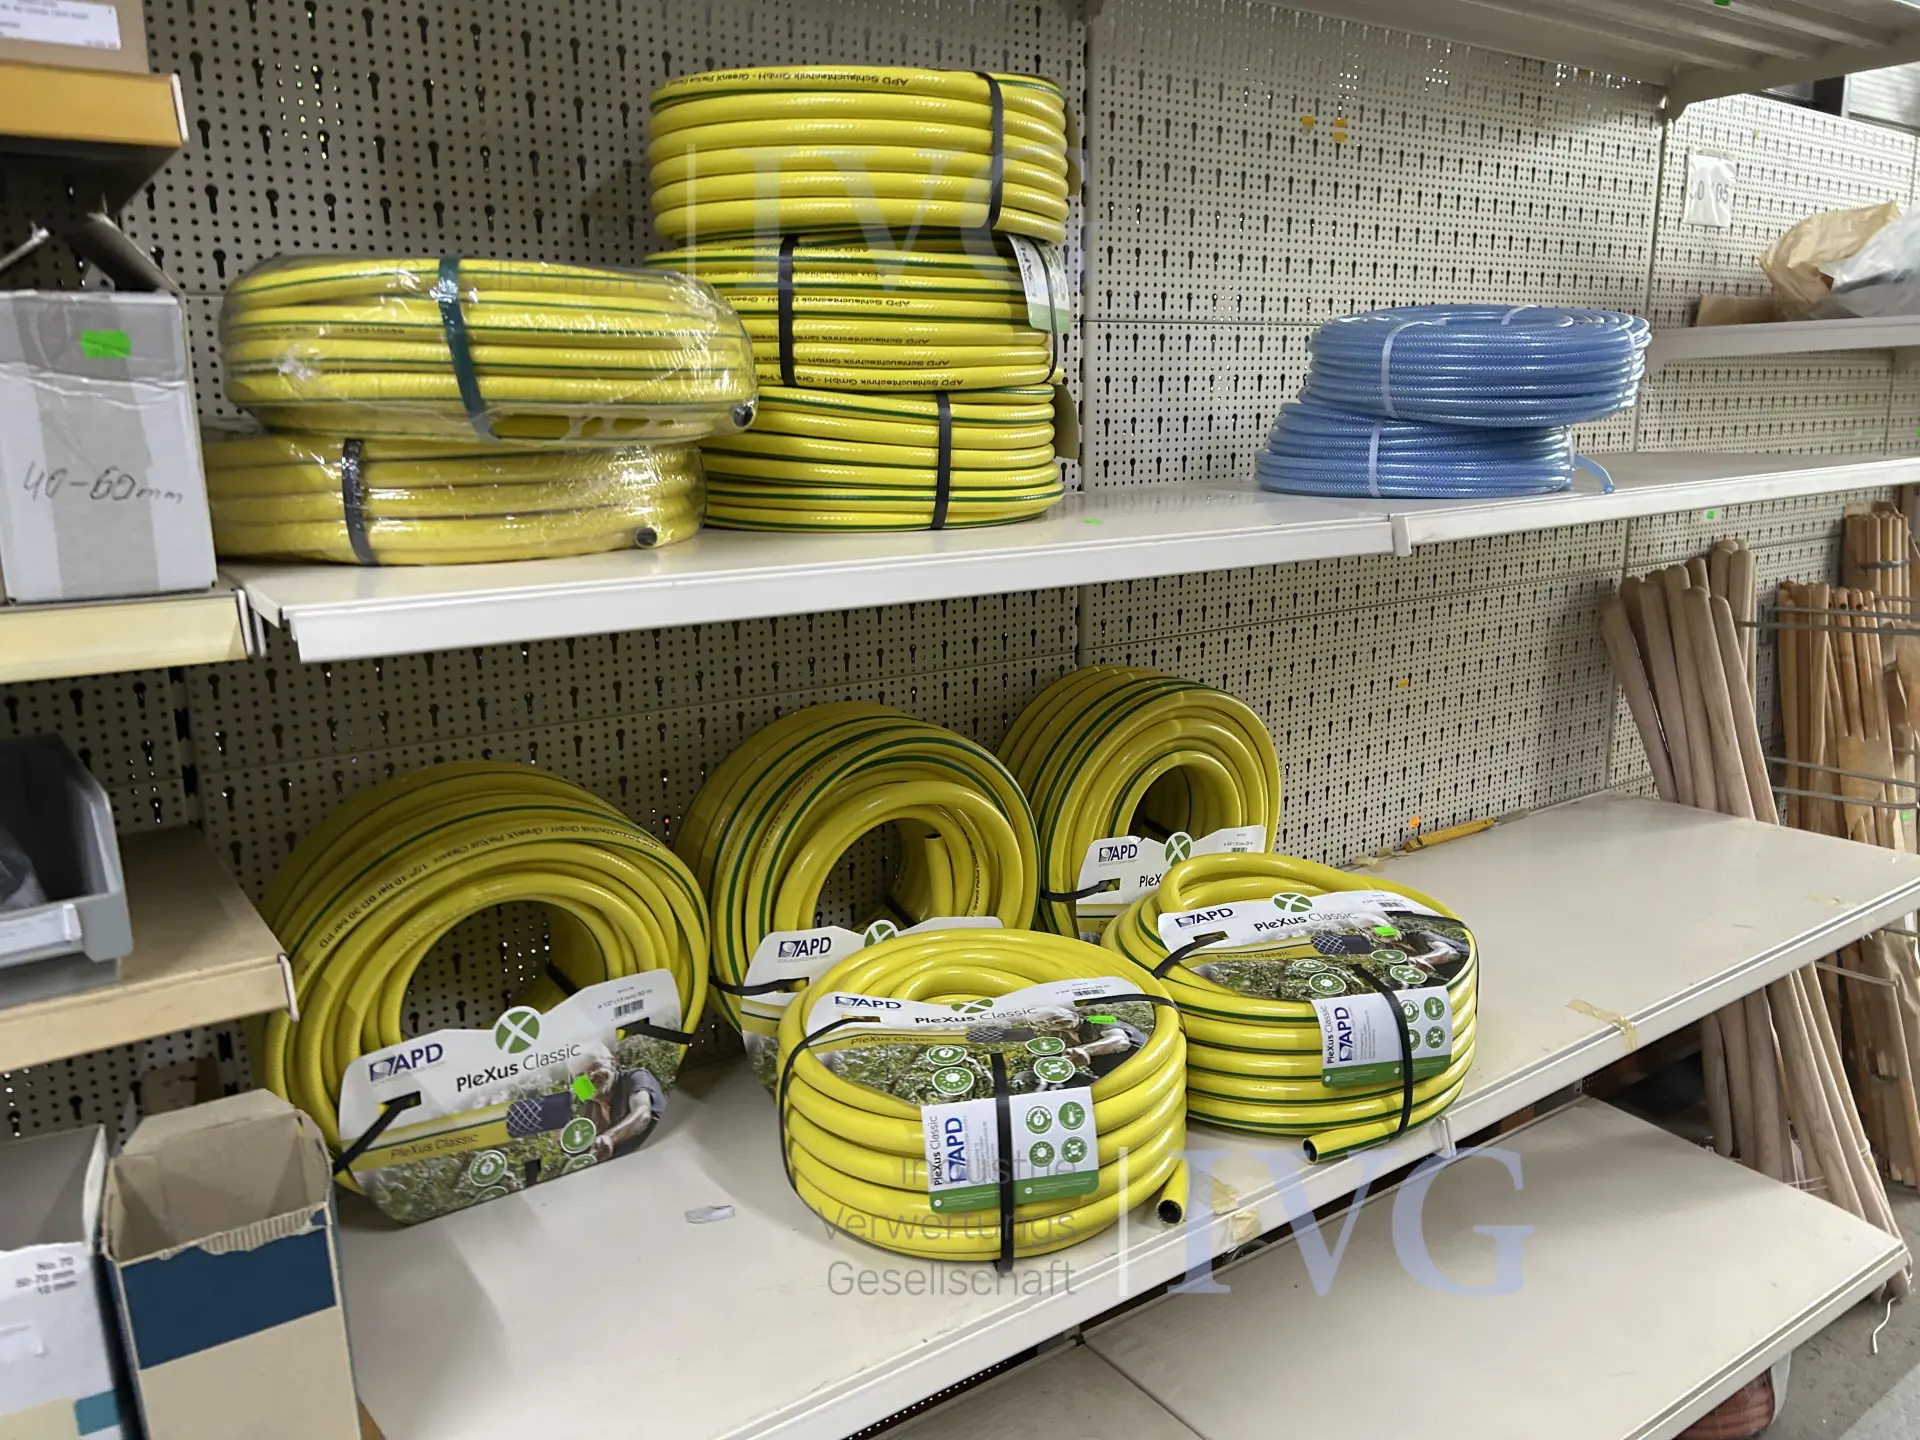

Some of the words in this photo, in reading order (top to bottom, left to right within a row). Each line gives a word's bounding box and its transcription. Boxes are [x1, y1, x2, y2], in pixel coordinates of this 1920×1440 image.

[758, 70, 791, 80] GmbH
[882, 77, 909, 88] APD
[886, 299, 911, 308] APD
[824, 376, 857, 386] GmbH
[942, 378, 965, 387] APD
[1111, 843, 1138, 861] APD
[1192, 907, 1234, 925] APD
[1254, 915, 1307, 932] PleXus
[1308, 911, 1358, 922] Classic
[796, 936, 832, 957] APD
[856, 997, 902, 1010] APD
[915, 1015, 976, 1025] PleXus
[979, 1006, 1038, 1021] Classic
[1320, 1004, 1333, 1033] Classic
[1334, 1006, 1353, 1045] APD
[392, 1042, 444, 1075] APD
[1326, 1034, 1335, 1065] PleXus
[456, 1063, 519, 1093] PleXus
[523, 1043, 582, 1071] Classic
[929, 1115, 940, 1150] Classic
[944, 1117, 967, 1164] APD
[934, 1151, 944, 1187] PleXus
